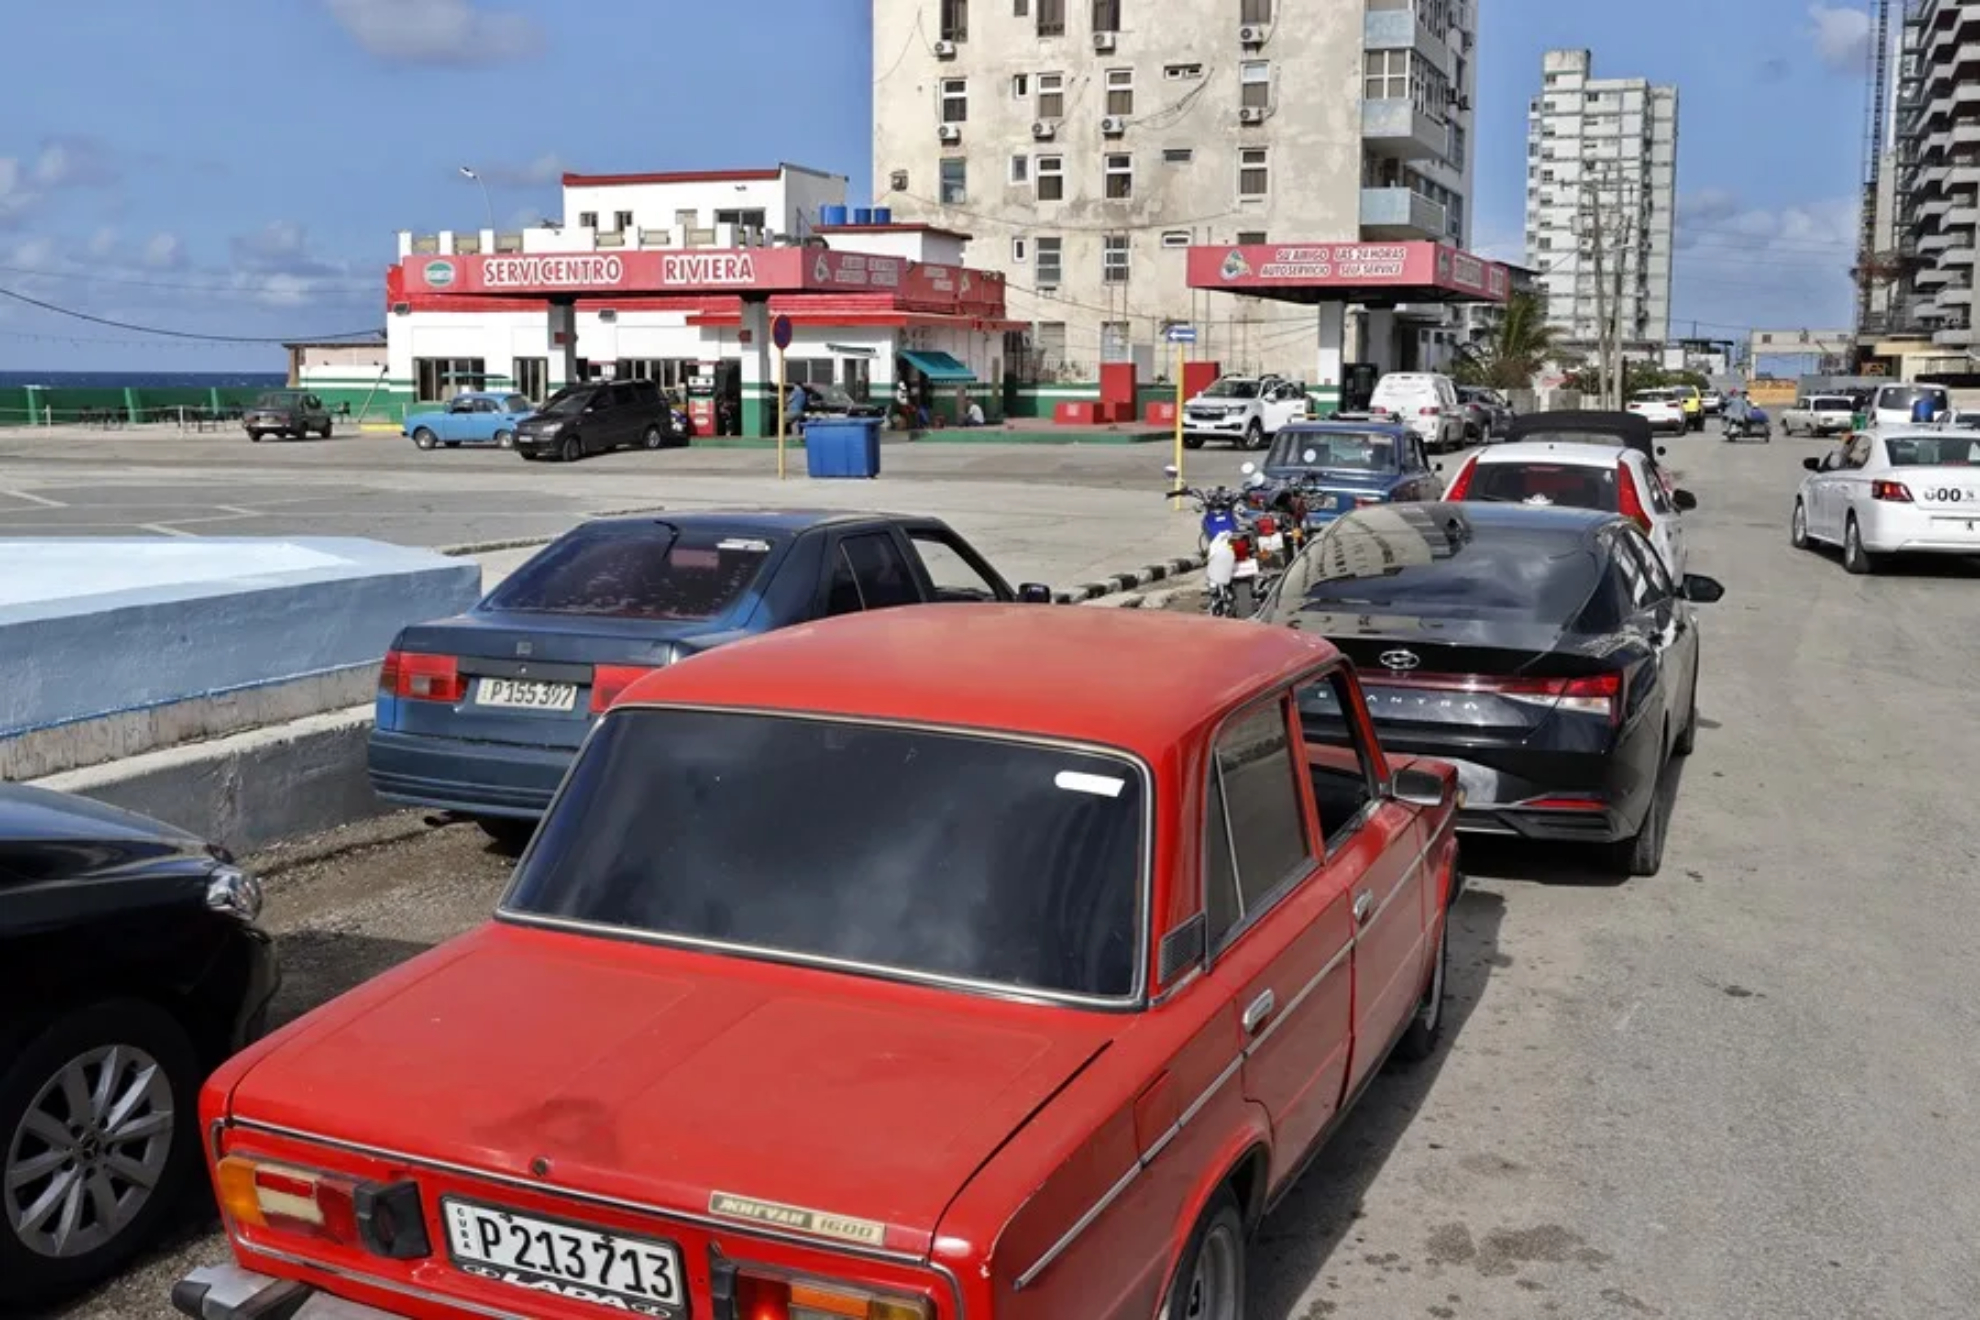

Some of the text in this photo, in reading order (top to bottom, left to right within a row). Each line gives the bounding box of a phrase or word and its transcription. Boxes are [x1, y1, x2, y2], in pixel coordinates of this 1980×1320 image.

[484, 256, 754, 285] SERVICENTRO RIVIERA
[1366, 694, 1478, 711] ANTRA
[457, 1207, 471, 1250] CUBA
[820, 1218, 874, 1239] 1600
